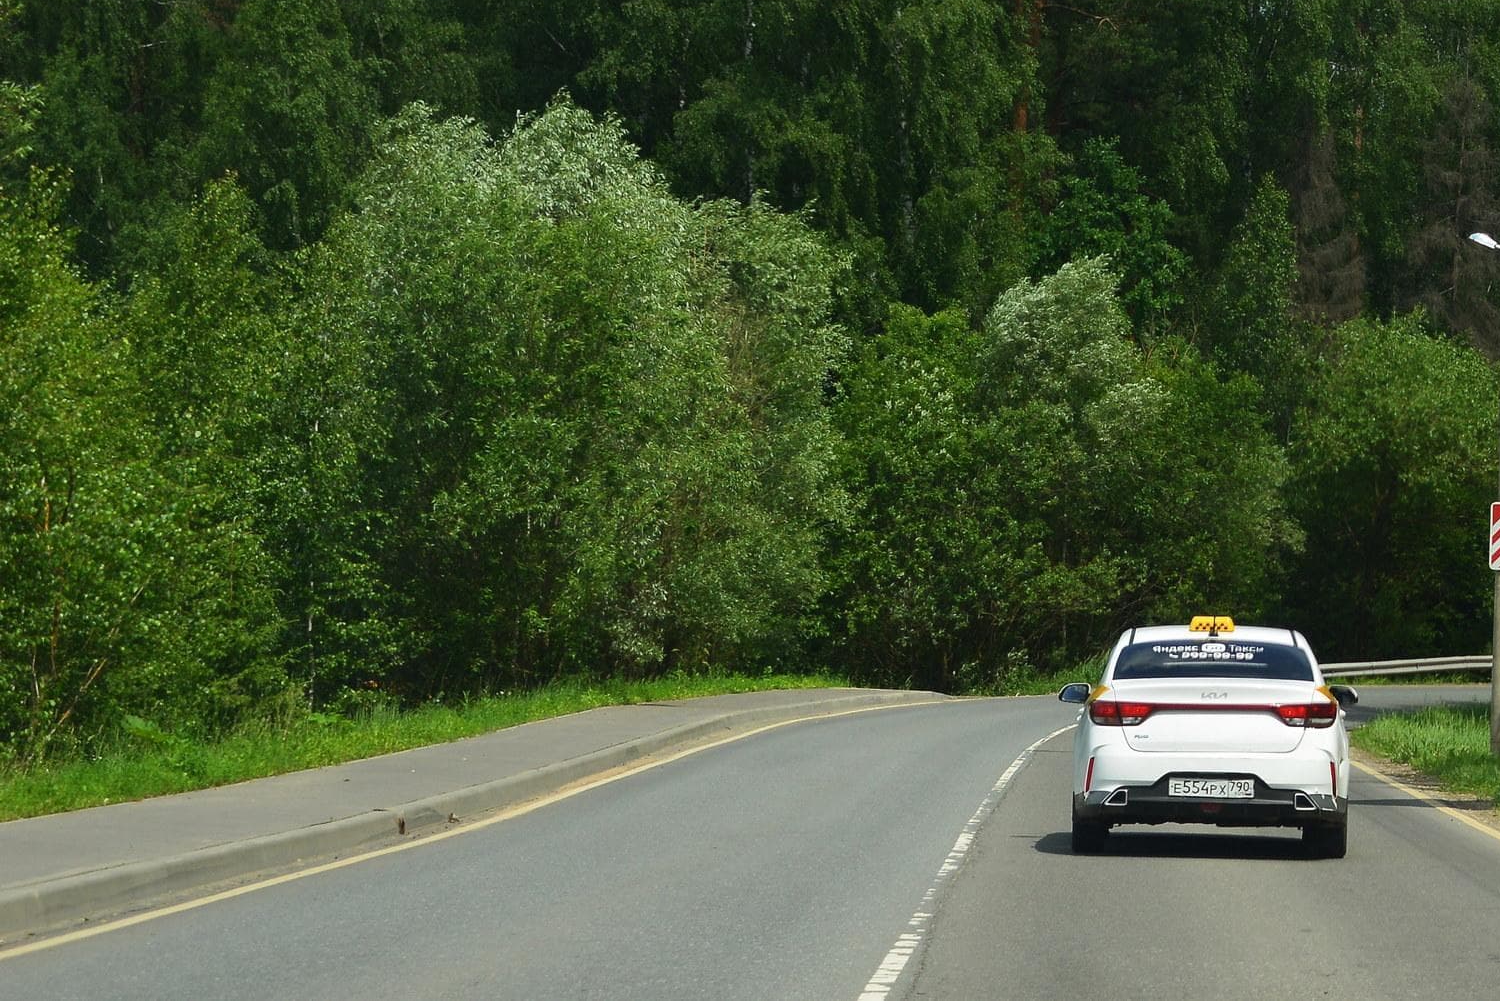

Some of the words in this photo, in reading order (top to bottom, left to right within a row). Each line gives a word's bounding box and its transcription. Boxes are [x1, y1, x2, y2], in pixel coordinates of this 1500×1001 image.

[1152, 645, 1198, 653] Яндекс
[1228, 644, 1264, 653] Такси
[1229, 781, 1250, 792] 790
